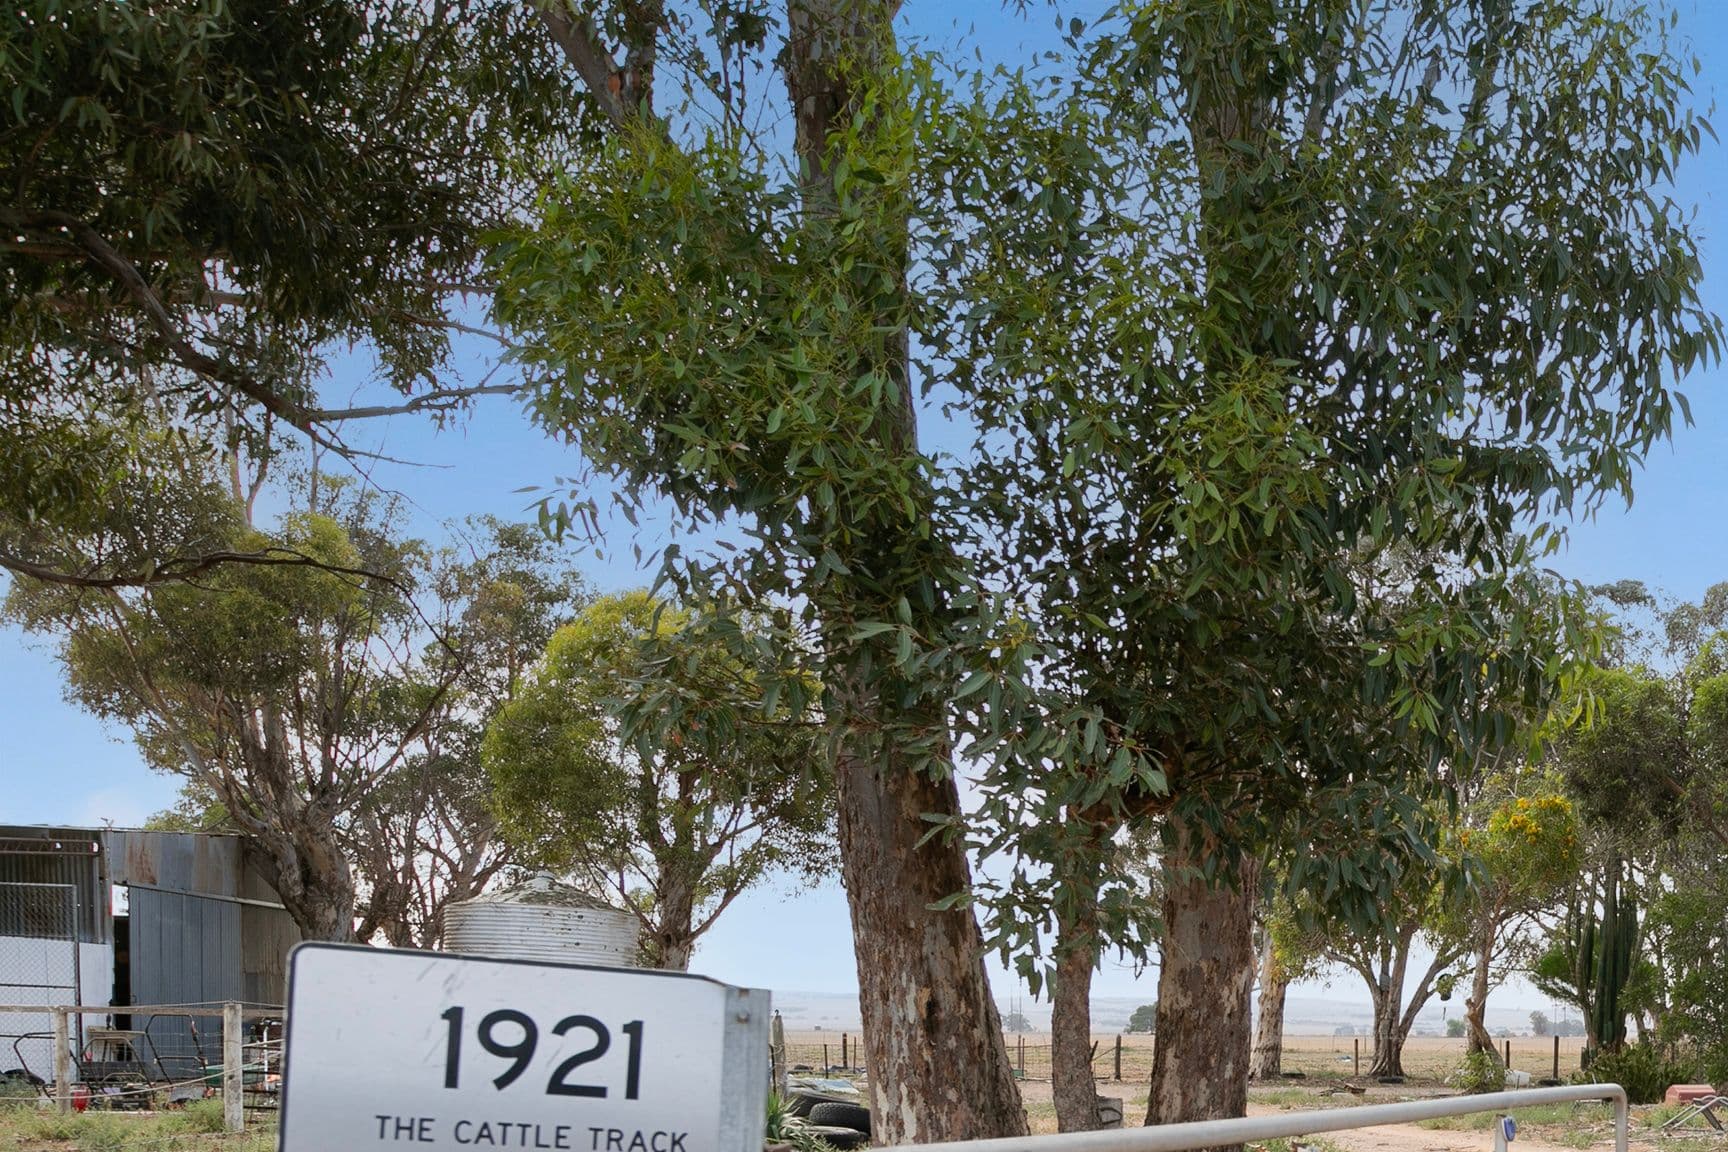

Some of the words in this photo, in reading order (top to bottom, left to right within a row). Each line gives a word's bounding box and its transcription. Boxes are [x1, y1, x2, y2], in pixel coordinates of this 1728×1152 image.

[440, 1005, 644, 1100] 1921
[375, 1115, 435, 1142] THE
[453, 1119, 572, 1149] CATTLE
